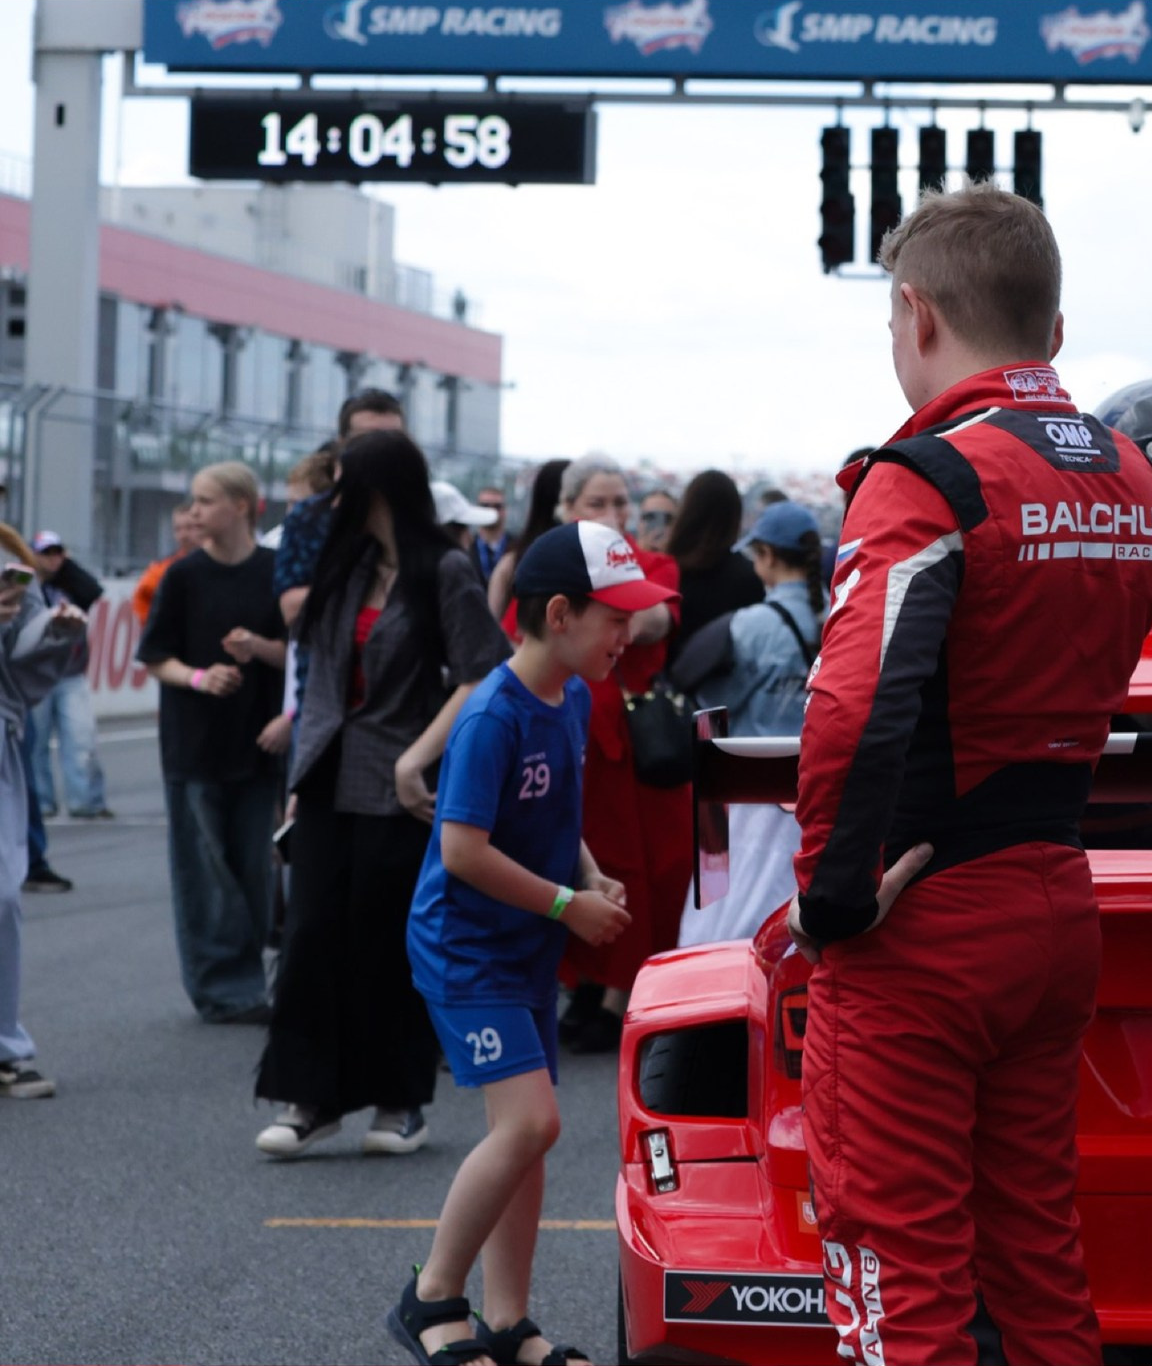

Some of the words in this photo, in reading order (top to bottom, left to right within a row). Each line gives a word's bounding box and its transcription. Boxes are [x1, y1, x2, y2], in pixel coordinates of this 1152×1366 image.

[368, 6, 441, 36] SMP
[442, 8, 561, 37] RACING
[800, 12, 872, 43] SMP
[874, 14, 998, 46] RACING
[257, 112, 512, 168] 14:04:58
[1045, 423, 1093, 448] OMP
[518, 763, 550, 800] 29
[464, 1025, 503, 1066] 29
[731, 1285, 827, 1314] YOKOH
